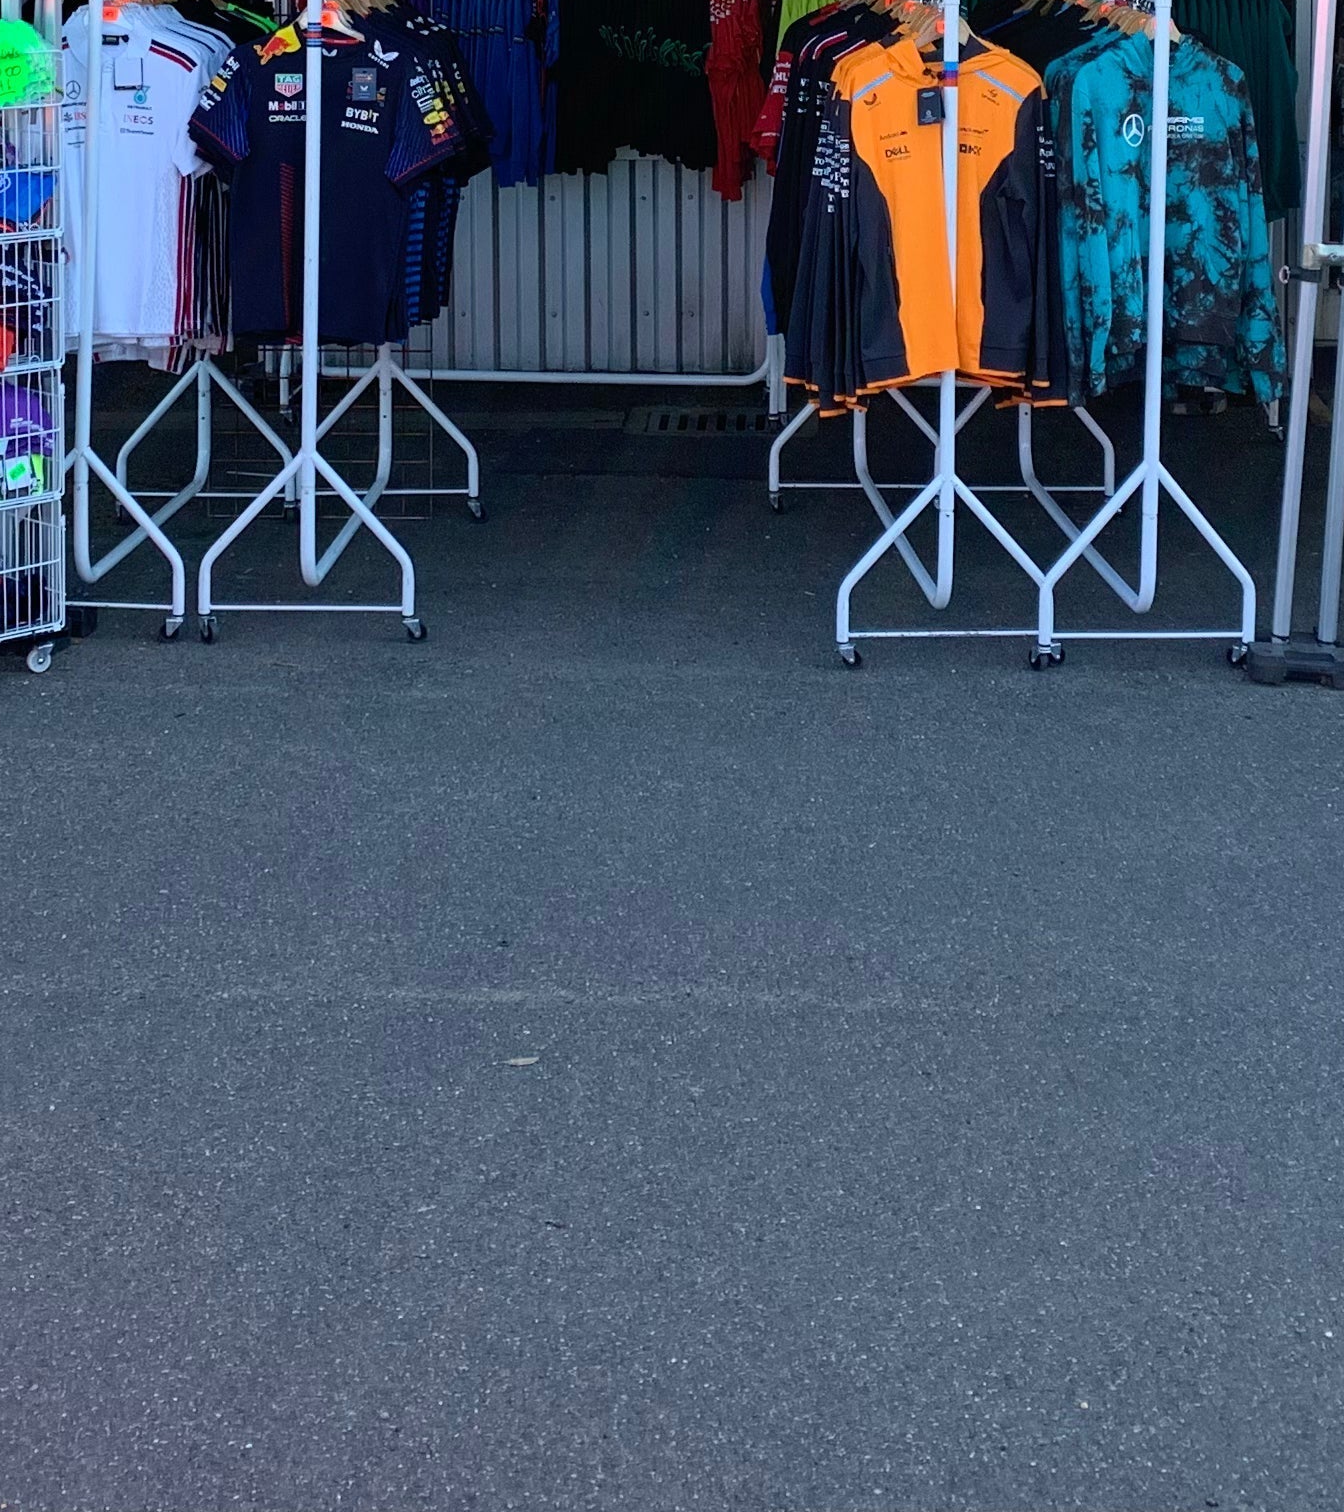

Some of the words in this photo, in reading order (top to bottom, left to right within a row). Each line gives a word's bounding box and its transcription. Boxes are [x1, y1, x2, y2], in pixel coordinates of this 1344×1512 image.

[345, 106, 380, 123] BYBIT
[340, 120, 379, 135] HONDA
[885, 145, 911, 158] DELL
